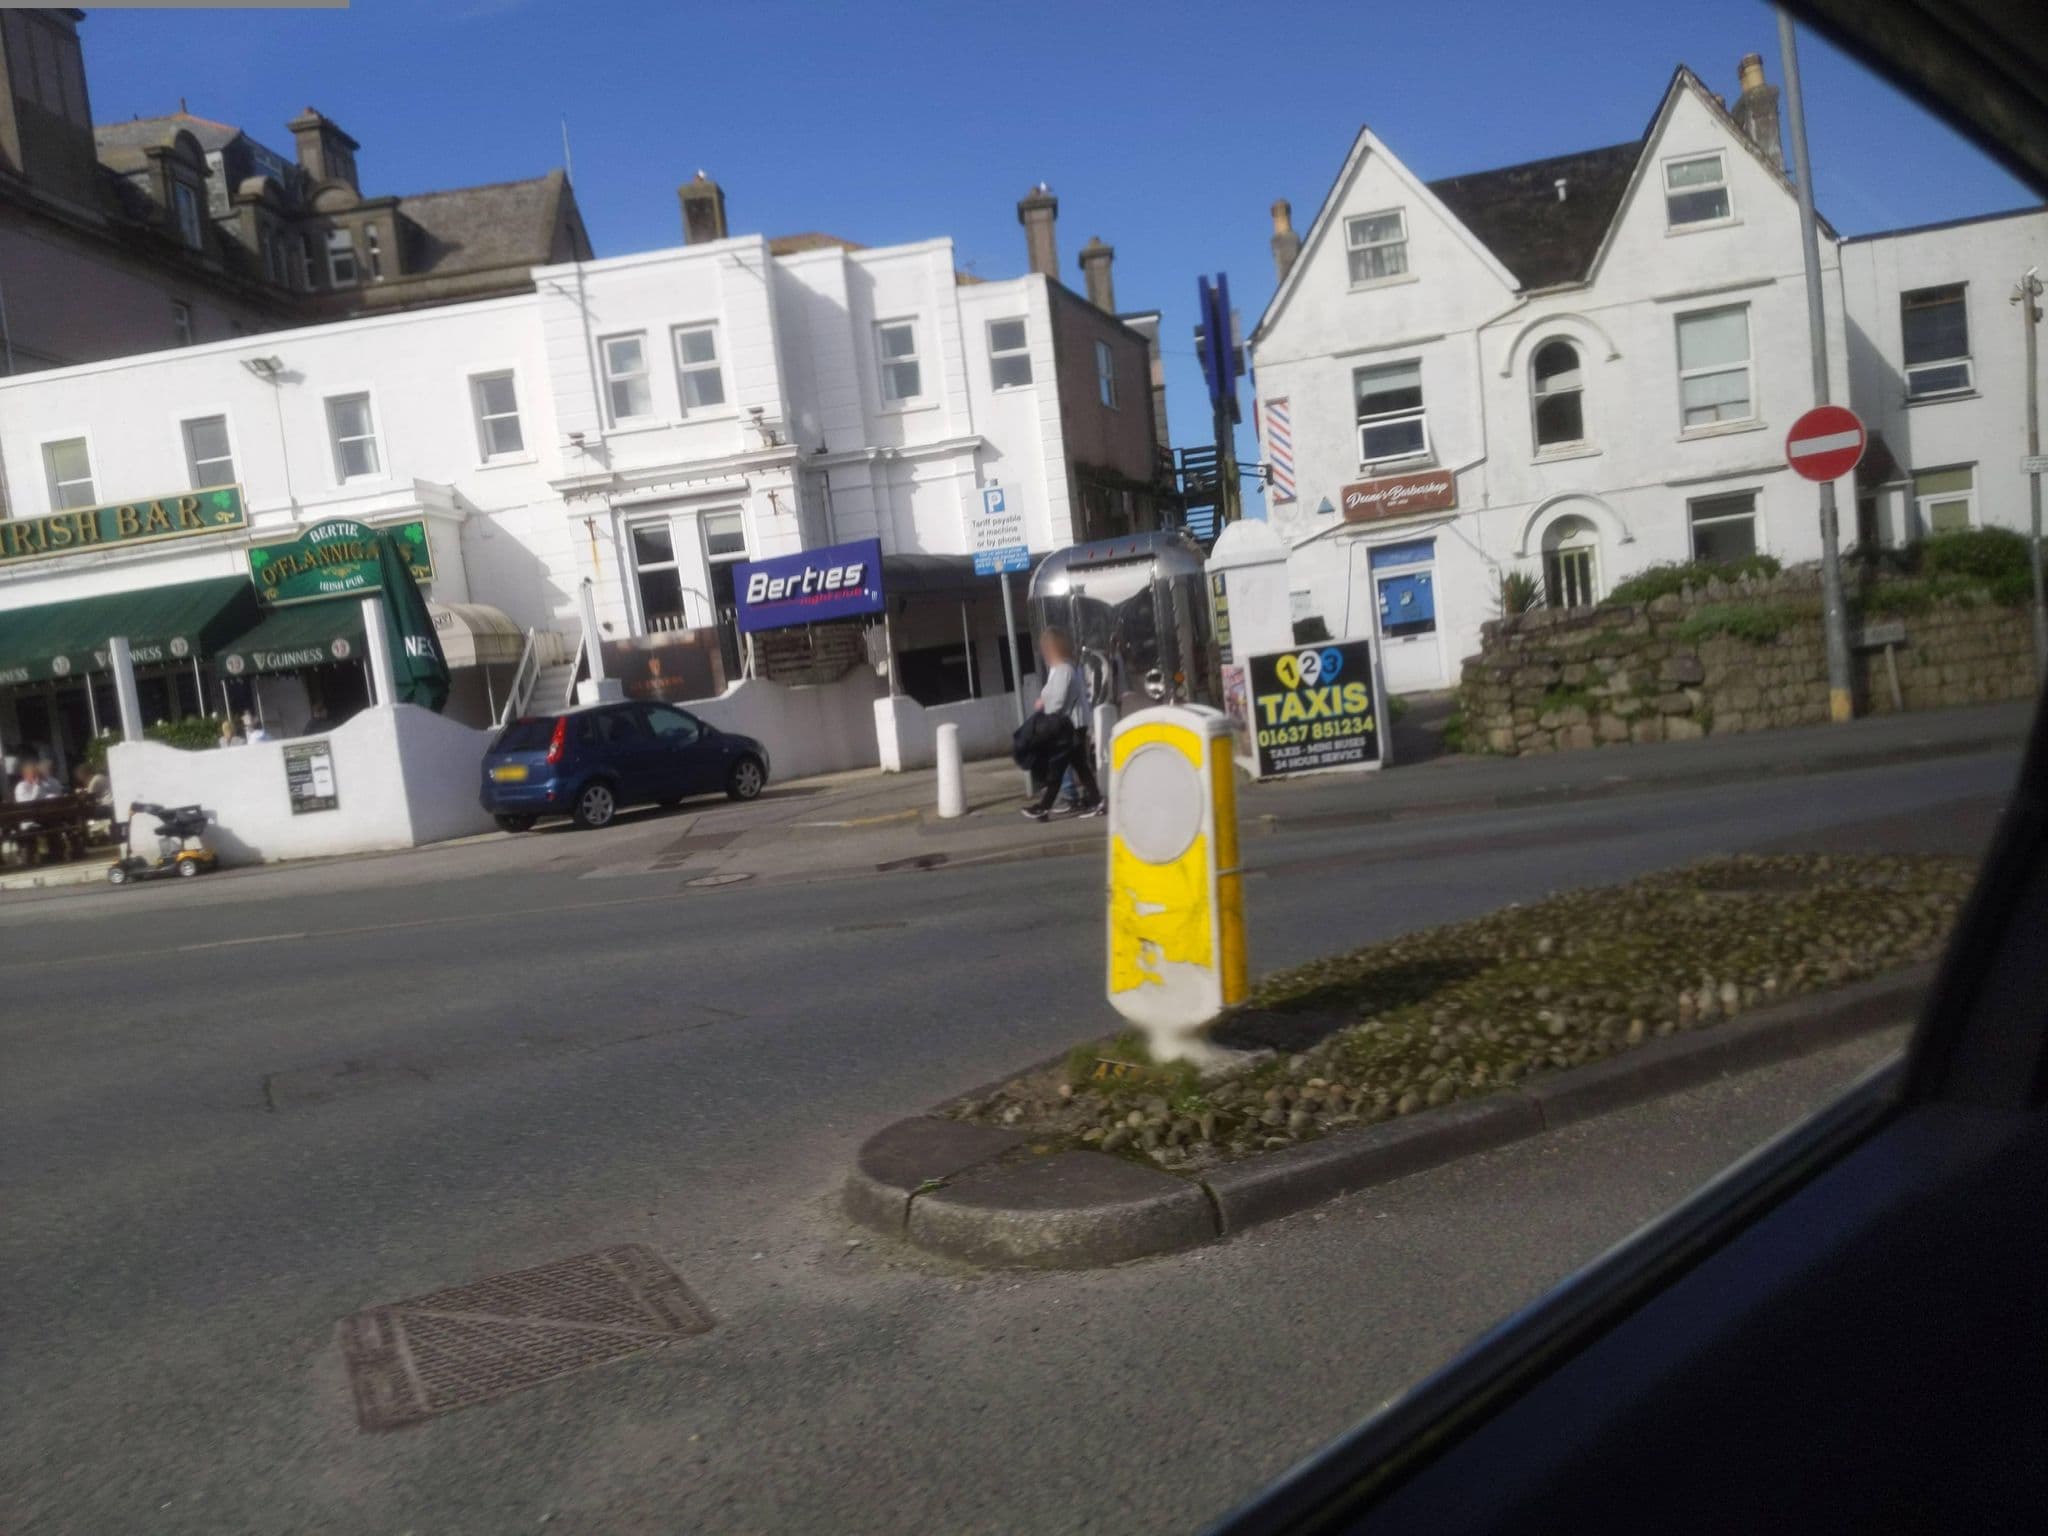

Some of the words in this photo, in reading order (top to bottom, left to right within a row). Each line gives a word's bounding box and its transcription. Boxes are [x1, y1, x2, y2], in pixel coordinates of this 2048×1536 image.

[986, 491, 1002, 513] P
[0, 510, 100, 557] IRISH
[116, 495, 206, 539] BAR
[993, 515, 1021, 526] payable
[309, 522, 358, 543] BERTIE
[986, 538, 996, 548] by
[998, 536, 1021, 546] phone
[987, 527, 1017, 537] machine
[319, 580, 345, 593] IRISH
[346, 574, 365, 590] PUB
[746, 563, 863, 604] Berties
[266, 647, 323, 670] GUINNESS
[1258, 682, 1369, 725] TAXIS
[1258, 725, 1309, 747] 01637
[1311, 715, 1374, 740] 851234
[1274, 759, 1288, 771] 24
[1288, 755, 1320, 768] HOUR
[1321, 748, 1363, 763] SERVICE
